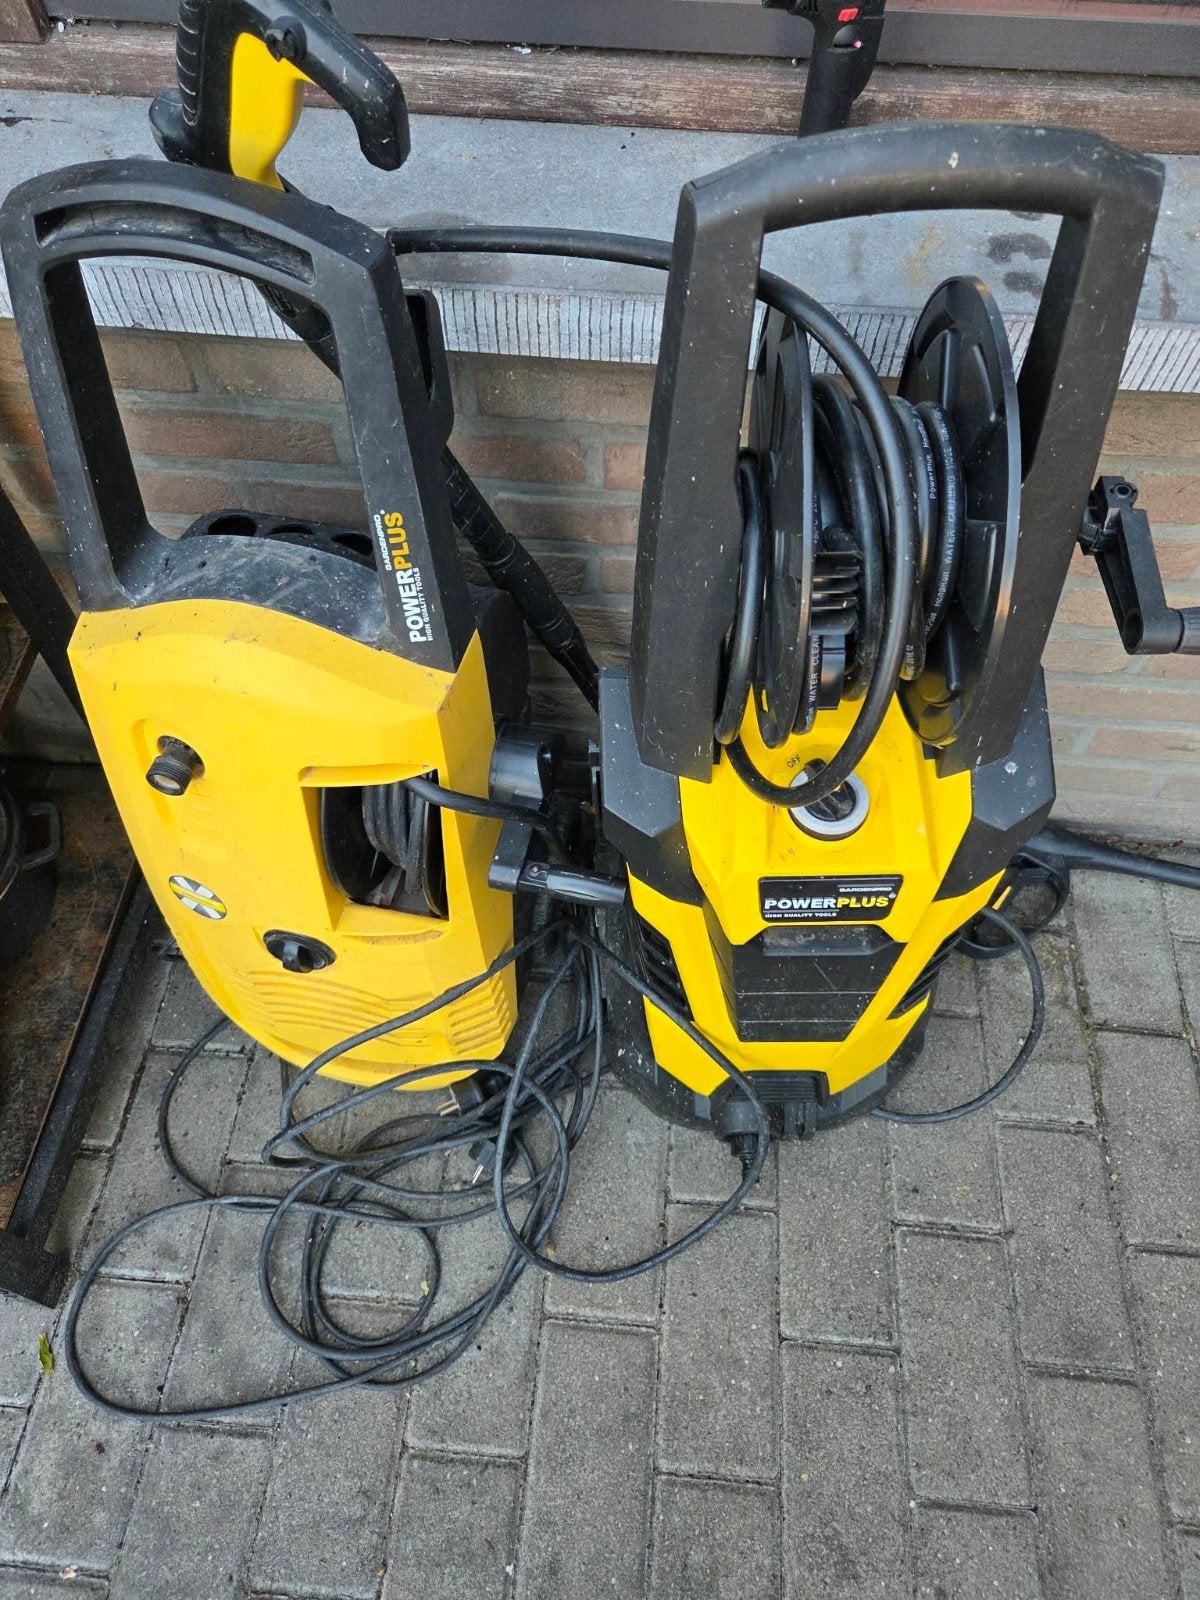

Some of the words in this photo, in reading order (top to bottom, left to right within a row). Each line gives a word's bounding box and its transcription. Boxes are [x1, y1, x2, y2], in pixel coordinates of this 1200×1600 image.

[373, 514, 392, 571] GARDENPRO
[944, 529, 956, 564] WATER
[383, 511, 427, 643] POWERPLUS
[412, 567, 423, 590] TOOLS
[418, 593, 430, 622] QUALITY
[425, 624, 434, 641] HIGH
[809, 672, 819, 703] WATER
[786, 754, 801, 768] OFF
[764, 896, 889, 909] POWERPLUS
